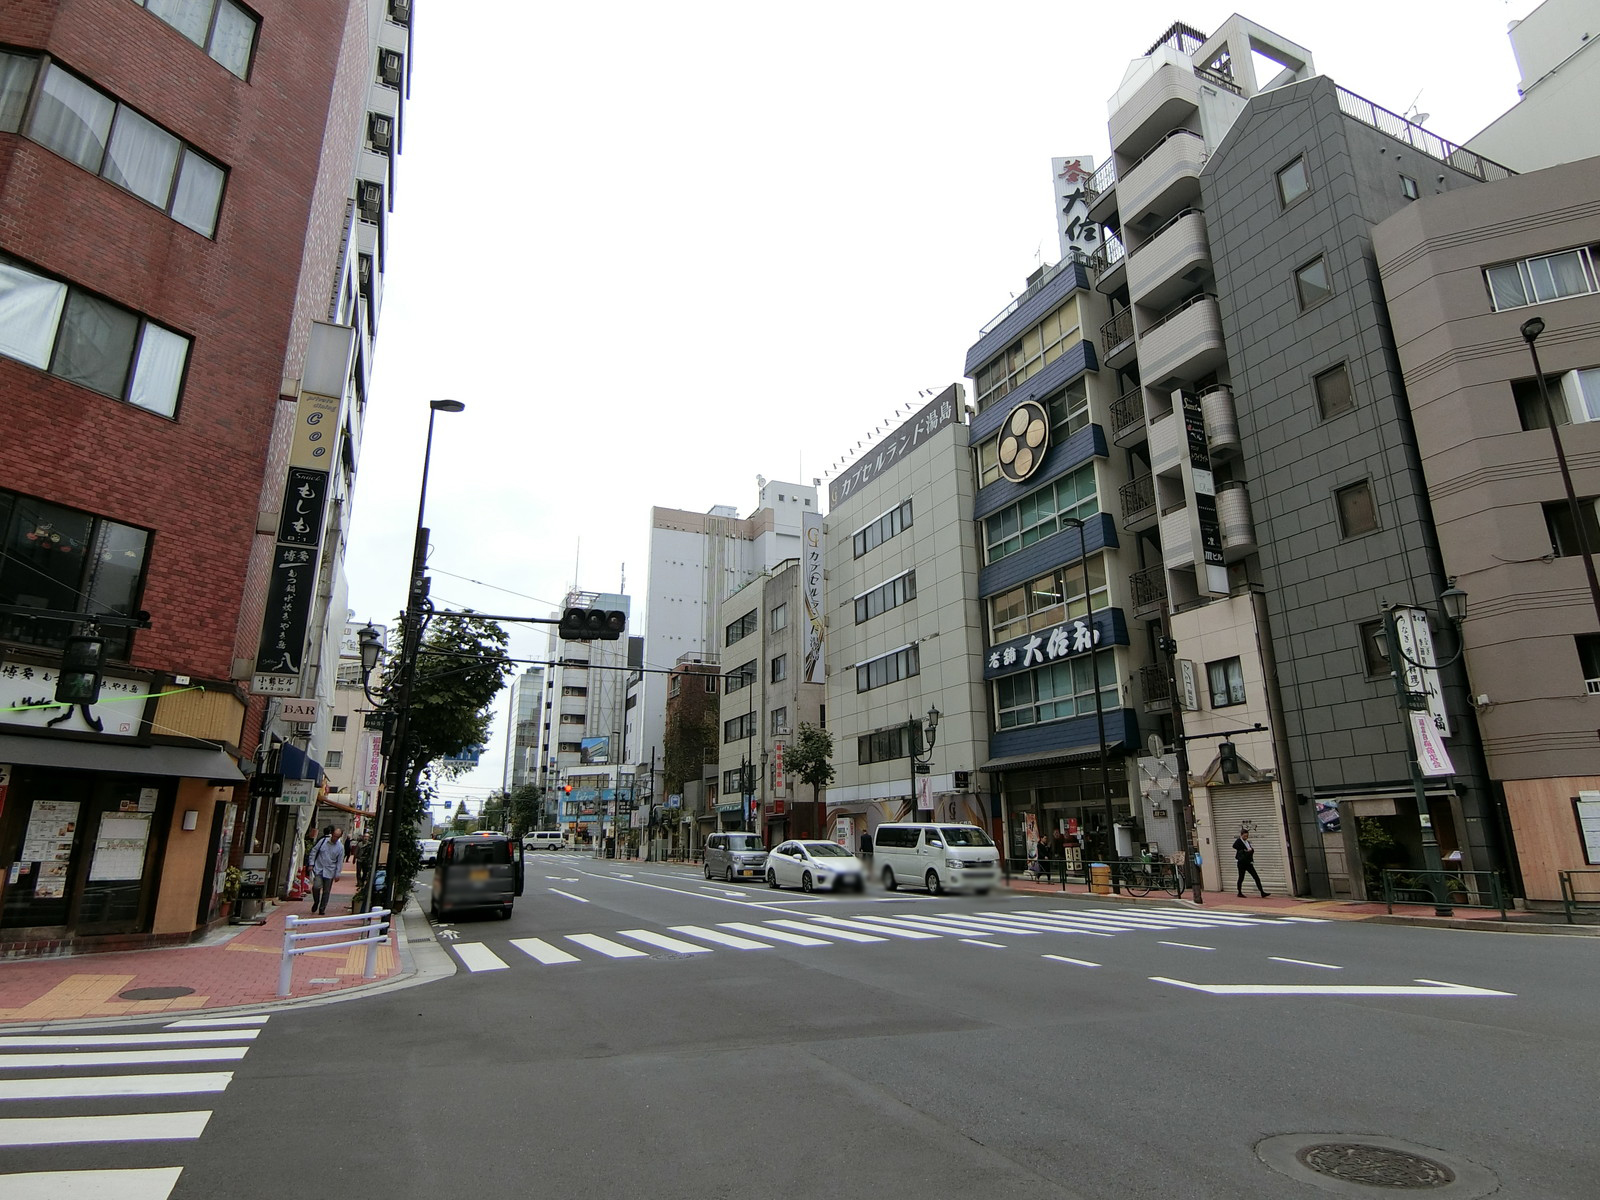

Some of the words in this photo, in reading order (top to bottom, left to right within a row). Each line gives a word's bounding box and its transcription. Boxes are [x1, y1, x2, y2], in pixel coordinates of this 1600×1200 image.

[841, 401, 951, 498] カプセルランド湯島
[291, 482, 316, 533] もしも
[271, 651, 299, 673] 八
[1023, 620, 1100, 667] 大佐和
[283, 704, 316, 715] BAR
